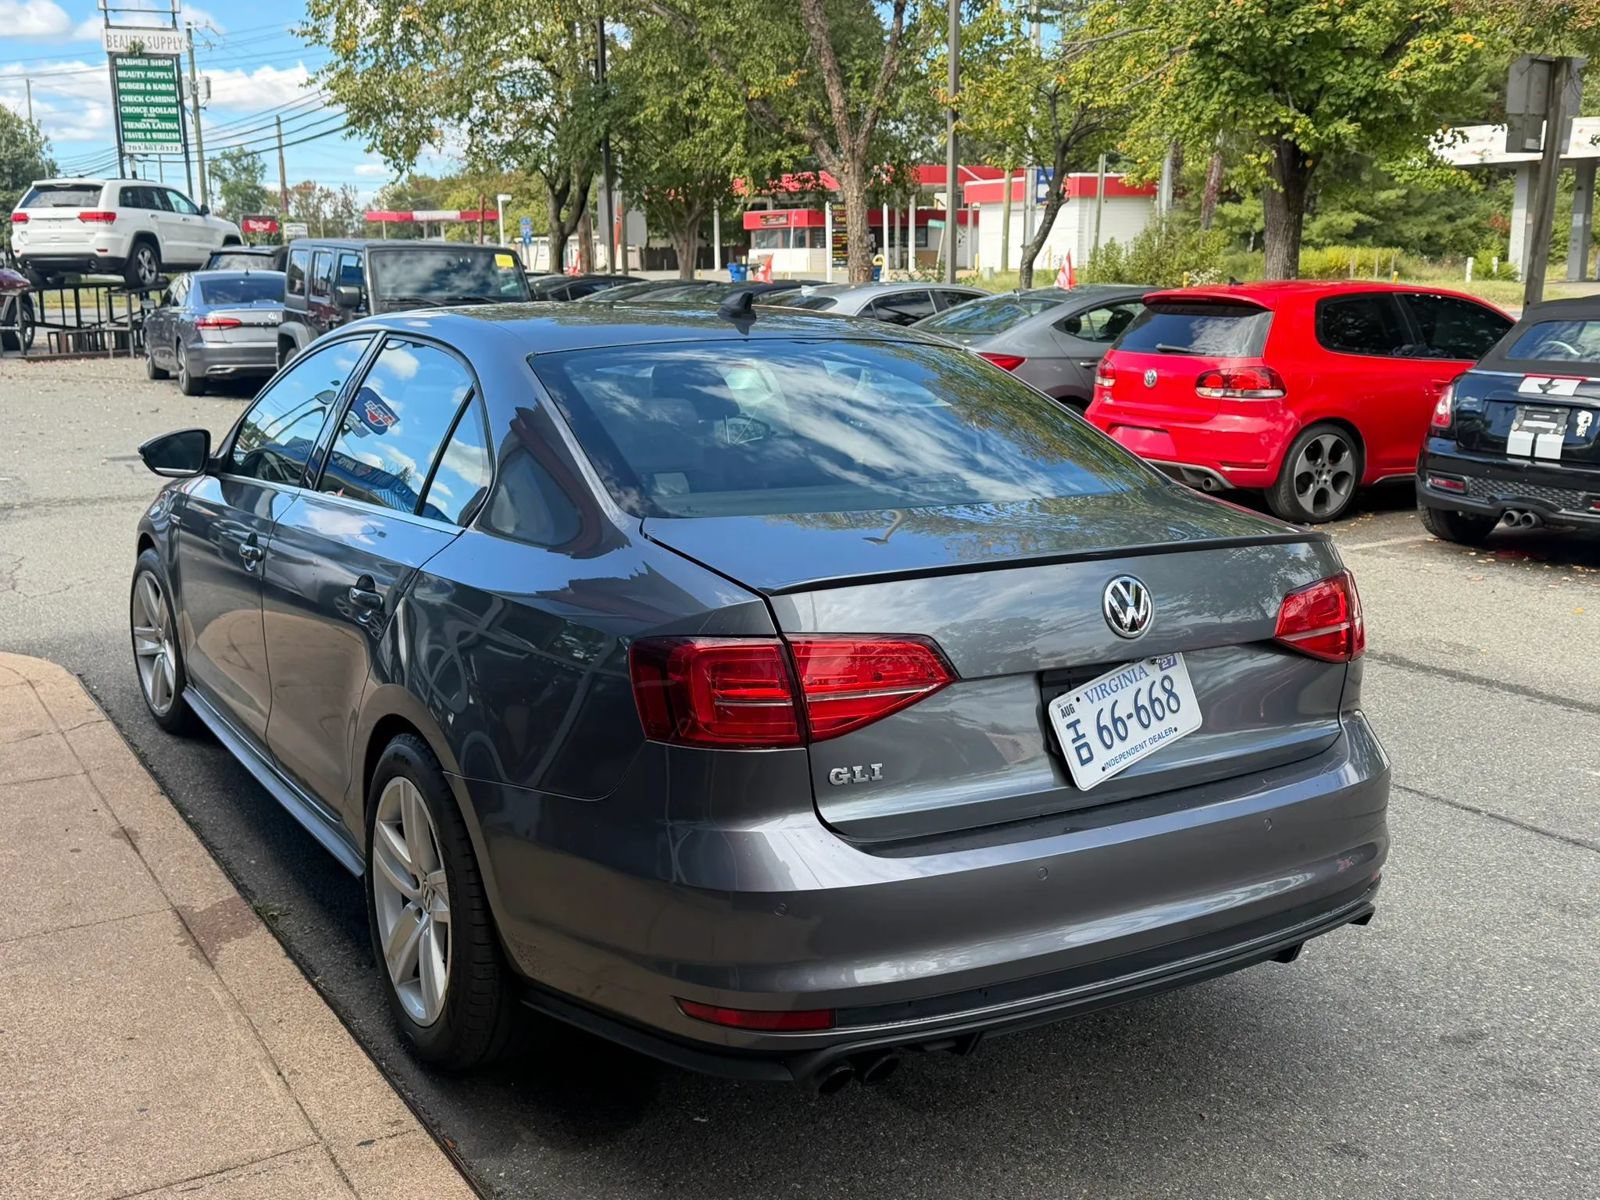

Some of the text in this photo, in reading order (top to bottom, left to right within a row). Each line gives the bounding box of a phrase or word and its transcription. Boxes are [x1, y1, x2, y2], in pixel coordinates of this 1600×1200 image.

[147, 35, 183, 50] SUPPLY
[1161, 655, 1175, 669] 27
[1084, 664, 1150, 704] VIRGINIA
[1060, 705, 1076, 719] AUG
[1096, 675, 1181, 750] 66-668
[1104, 727, 1174, 770] INDEPENDENT DEALER
[829, 763, 883, 786] GLI
